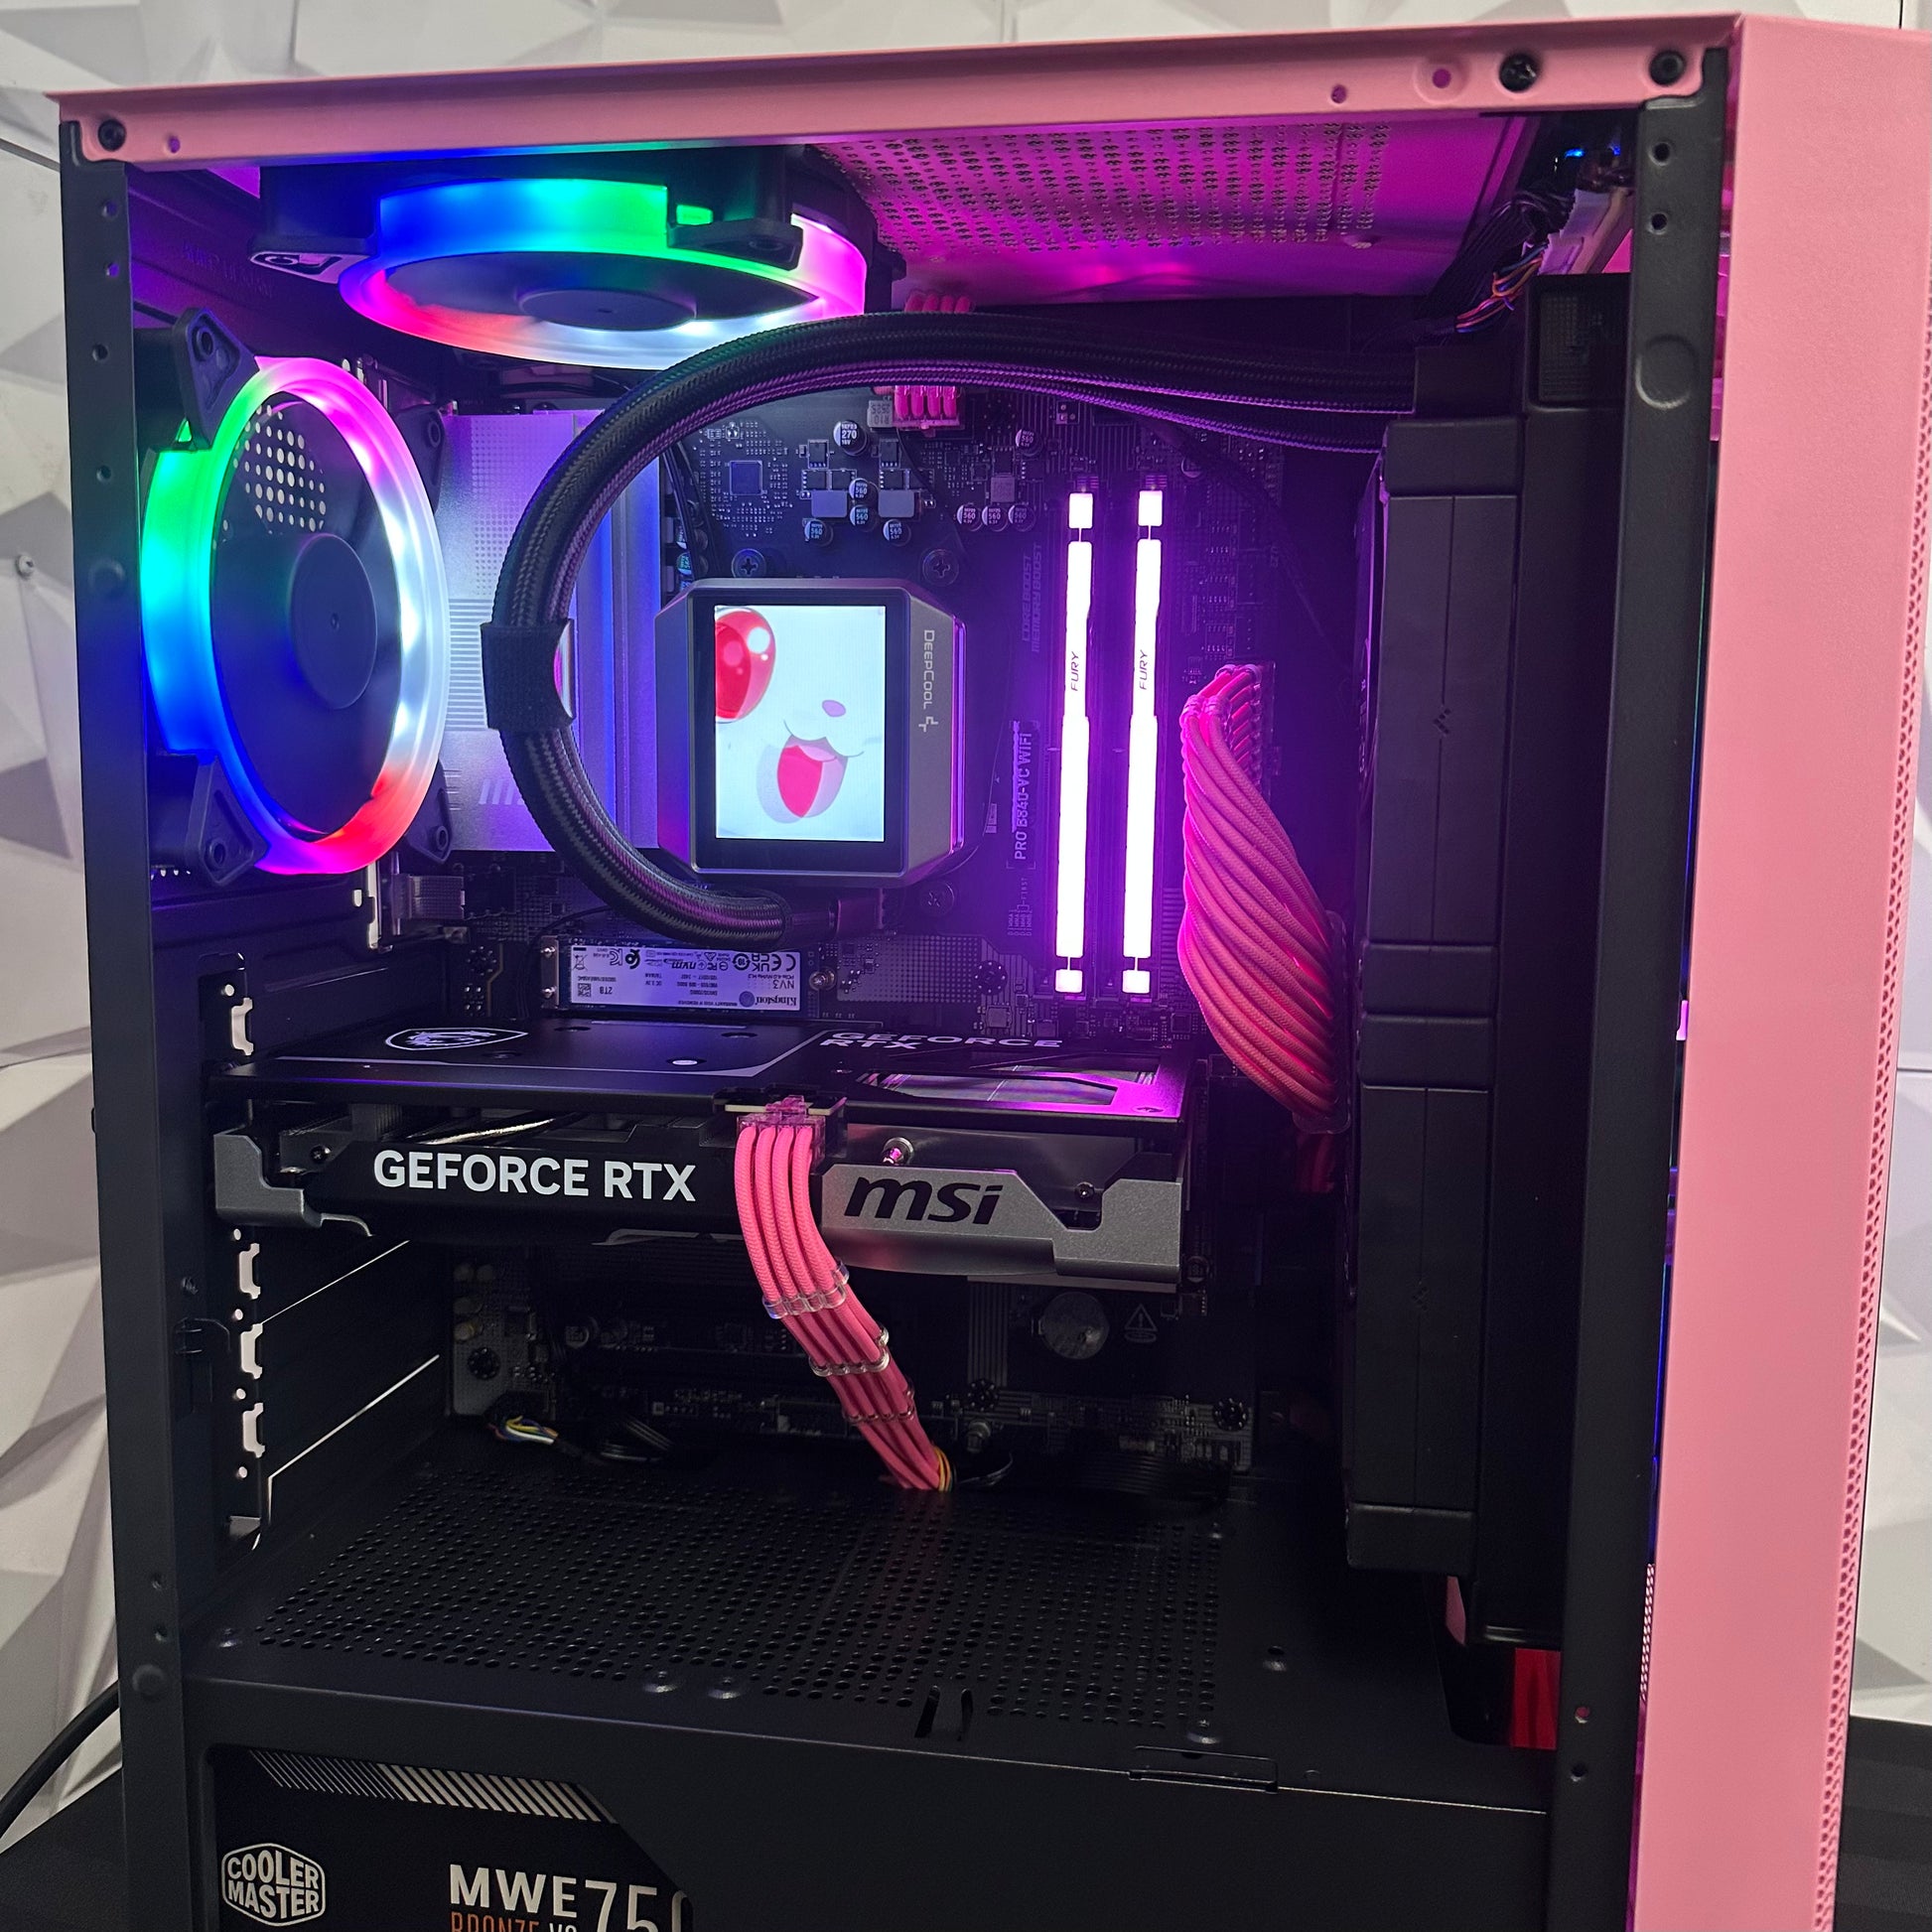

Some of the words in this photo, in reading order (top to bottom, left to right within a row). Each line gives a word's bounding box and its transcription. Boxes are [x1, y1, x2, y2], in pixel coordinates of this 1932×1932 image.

[841, 430, 858, 439] 270
[1070, 651, 1079, 691] FURY
[1139, 649, 1148, 690] FURY
[1014, 831, 1028, 860] PRO
[599, 986, 614, 995] 2TB
[756, 995, 797, 1007] Kingston
[772, 979, 795, 990] NV3
[819, 1038, 921, 1049] RTX
[832, 1032, 1063, 1047] GEFORCE
[373, 1149, 590, 1197] GEFORCE
[604, 1161, 696, 1202] RTX
[844, 1176, 1004, 1225] msi
[227, 1850, 319, 1889] COOLER
[227, 1879, 320, 1919] MASTER
[450, 1863, 578, 1918] MWE
